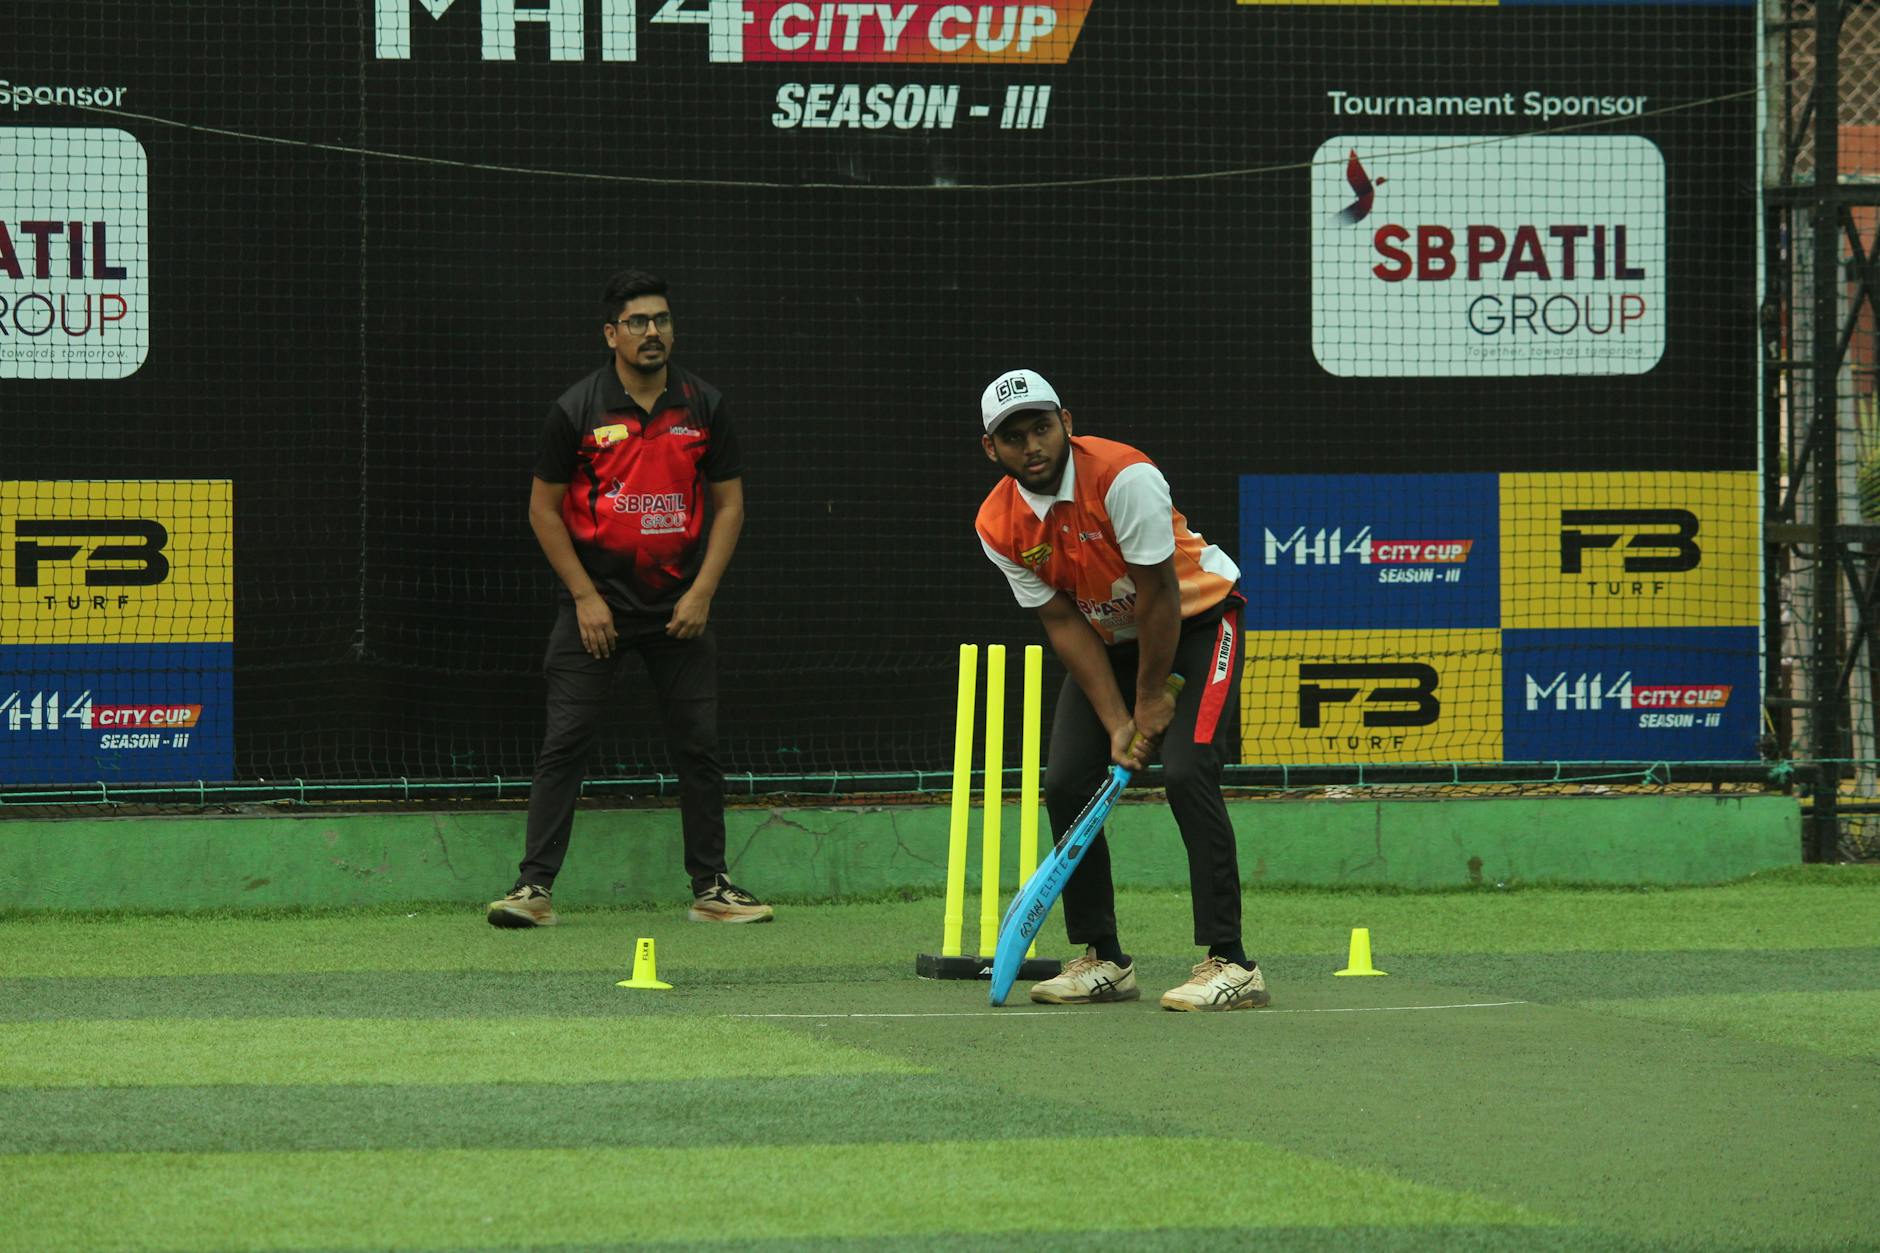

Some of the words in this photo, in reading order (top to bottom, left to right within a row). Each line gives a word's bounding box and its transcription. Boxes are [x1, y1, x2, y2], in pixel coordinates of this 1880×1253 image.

[769, 2, 918, 51] CITY
[928, 5, 1057, 53] CUP
[772, 83, 960, 129] SEASON
[1000, 85, 1051, 129] III
[1328, 90, 1515, 115] Tournament
[1523, 91, 1648, 121] Sponsor
[1468, 295, 1646, 335] GROUP
[2, 348, 55, 358] towards
[641, 511, 687, 528] GROUP
[1265, 526, 1374, 565] MH14
[1378, 545, 1419, 561] CITY
[1424, 545, 1463, 561] CUP
[1378, 568, 1433, 583] SEASON
[1587, 581, 1664, 595] TURF
[44, 595, 129, 610] TURF
[1219, 631, 1232, 660] TROPHY
[1526, 671, 1634, 710] MH14
[1638, 691, 1681, 706] CITY
[1684, 690, 1723, 705] CUP
[99, 710, 145, 725] CITY
[149, 709, 192, 725] CUP
[1638, 713, 1693, 728] SEASON
[100, 734, 160, 749] SEASON
[1326, 736, 1404, 750] TURF
[1040, 857, 1069, 898] ELITE
